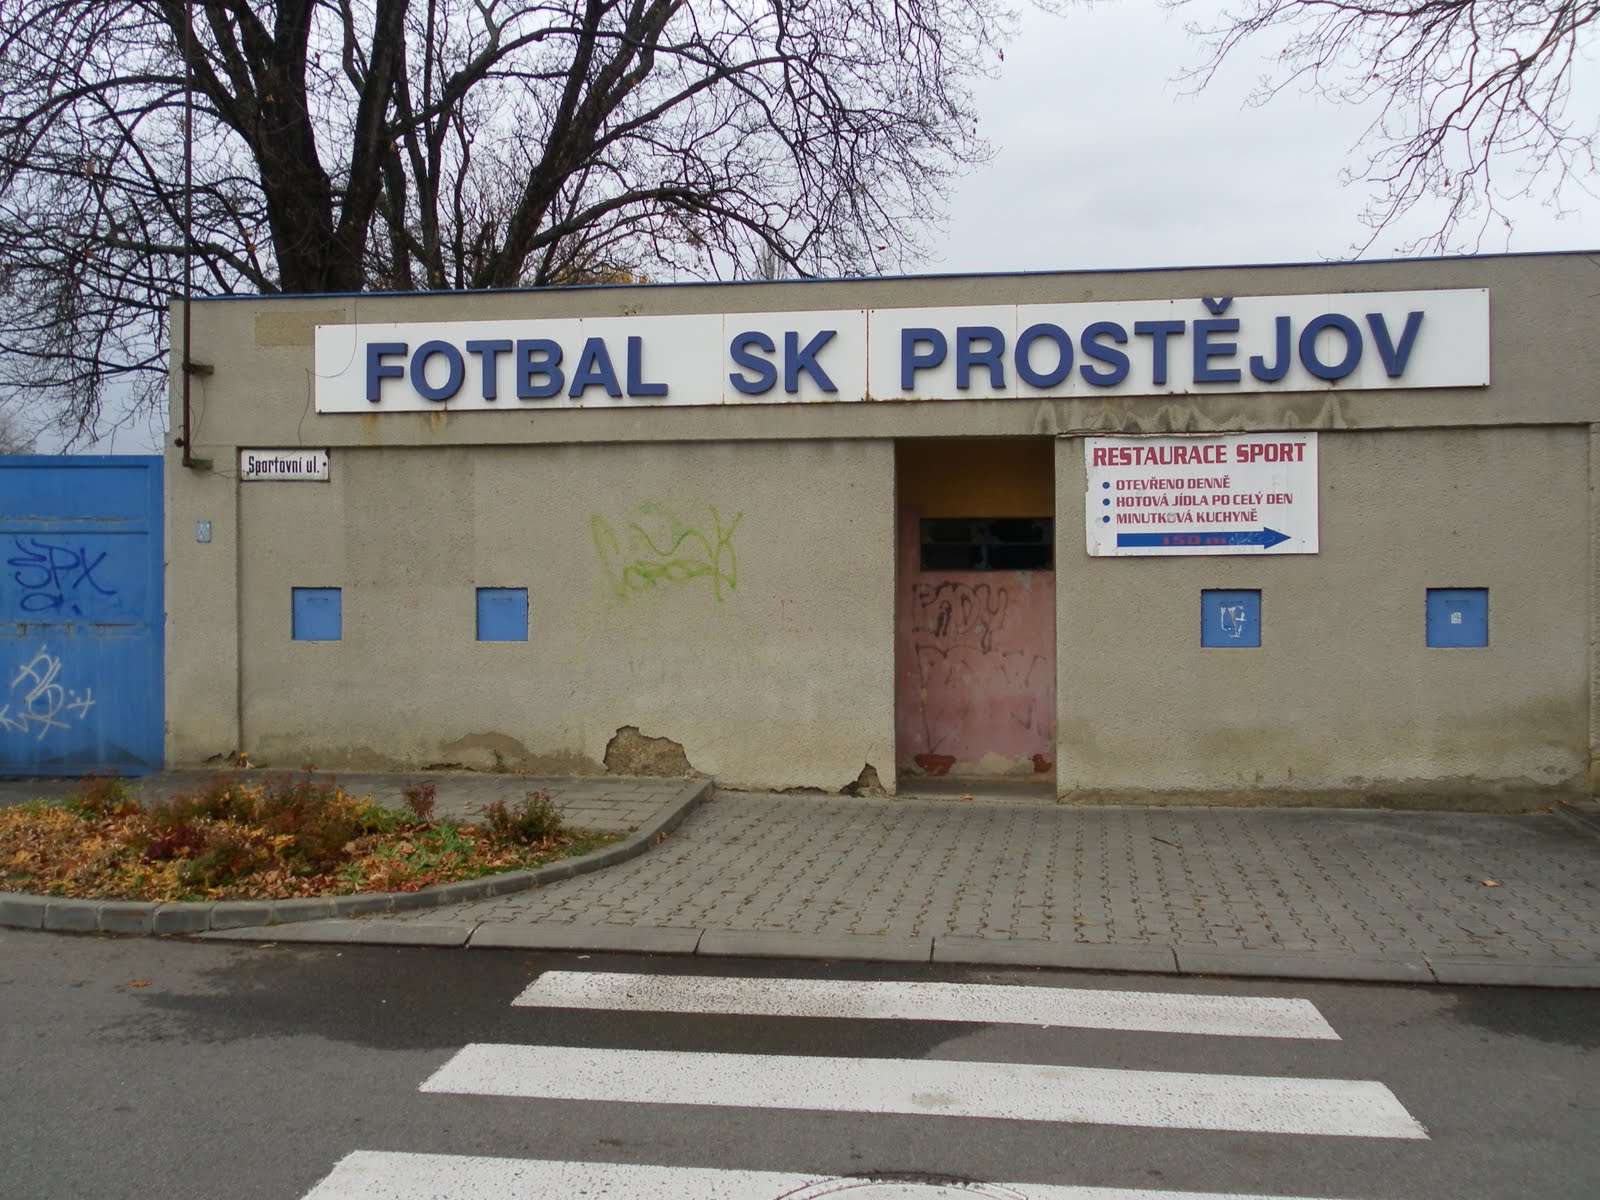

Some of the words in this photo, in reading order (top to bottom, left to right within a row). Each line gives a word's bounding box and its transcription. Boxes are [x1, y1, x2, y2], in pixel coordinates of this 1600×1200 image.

[366, 335, 669, 403] FOTBAL
[729, 330, 839, 396] SK
[900, 297, 1425, 390] PROSTĚJOV
[1093, 444, 1227, 467] RESTAURACE
[1236, 442, 1306, 464] SPORT
[248, 455, 302, 476] Sportovní
[306, 455, 320, 474] ul.
[1115, 476, 1185, 491] OTEVŘENO
[1187, 474, 1231, 489] DENNĚ
[1115, 493, 1169, 508] HOTOVÁ
[1171, 492, 1209, 507] JÍDLA
[1211, 494, 1230, 506] PO
[1233, 490, 1264, 506] CELÝ
[1266, 493, 1293, 505] DEN
[1196, 507, 1258, 523] KUCHYNĚ
